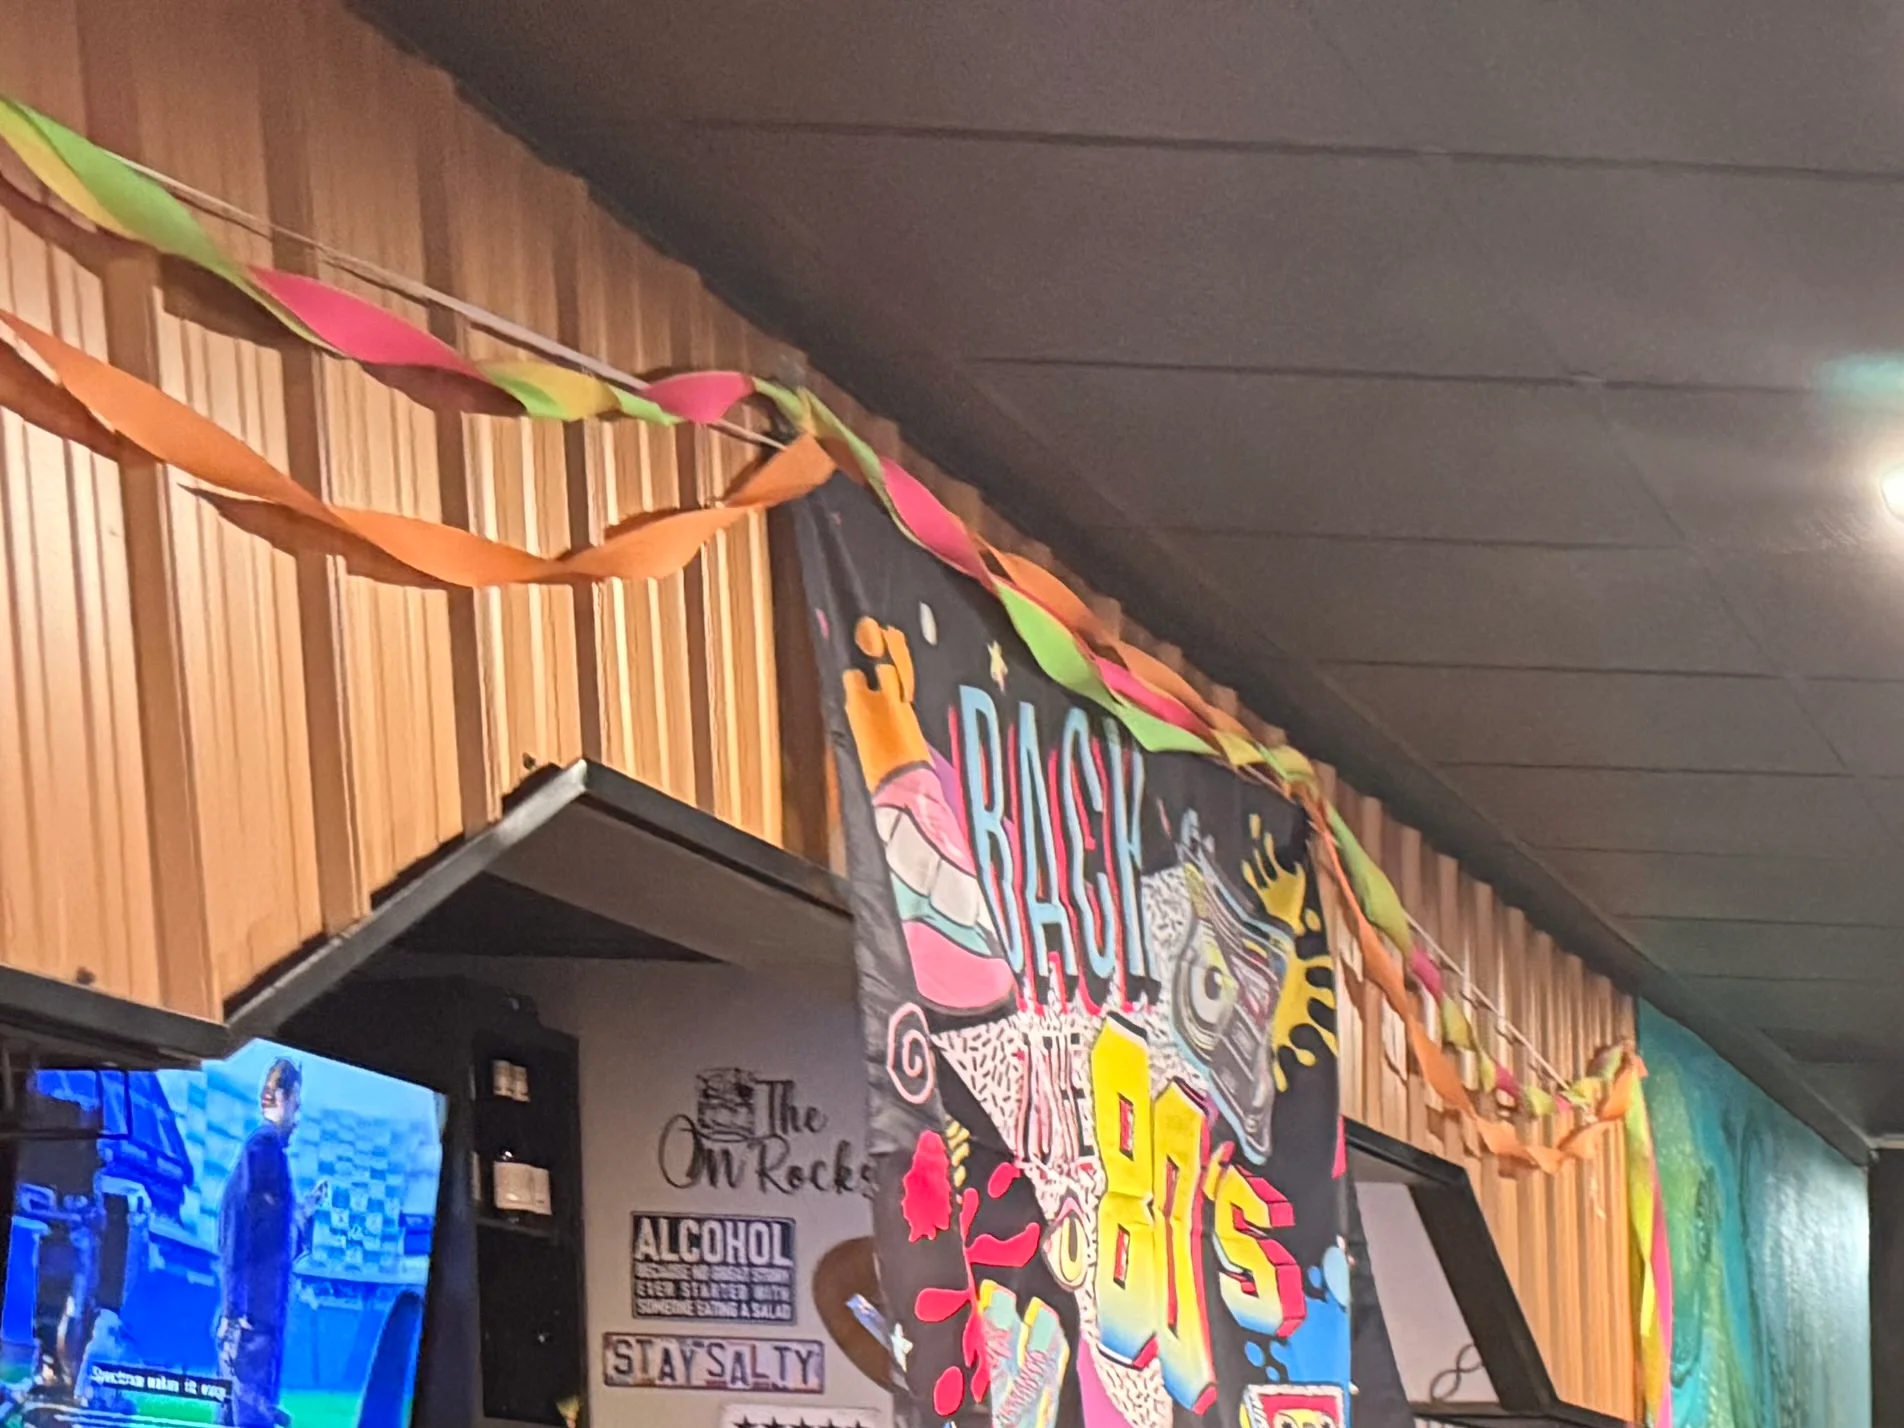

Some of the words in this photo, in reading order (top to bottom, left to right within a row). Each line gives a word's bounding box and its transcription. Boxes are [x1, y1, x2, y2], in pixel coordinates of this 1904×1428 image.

[754, 1079, 828, 1135] The
[658, 1114, 746, 1189] On
[749, 1134, 879, 1201] Rocks
[634, 1217, 792, 1266] ALCOHOL
[636, 1281, 675, 1297] EVER
[636, 1299, 695, 1315] SOMEONE
[696, 1301, 738, 1317] EATING
[740, 1303, 750, 1317] A
[751, 1303, 791, 1319] SALAD
[613, 1338, 698, 1382] STAY
[706, 1342, 813, 1386] SALTY
